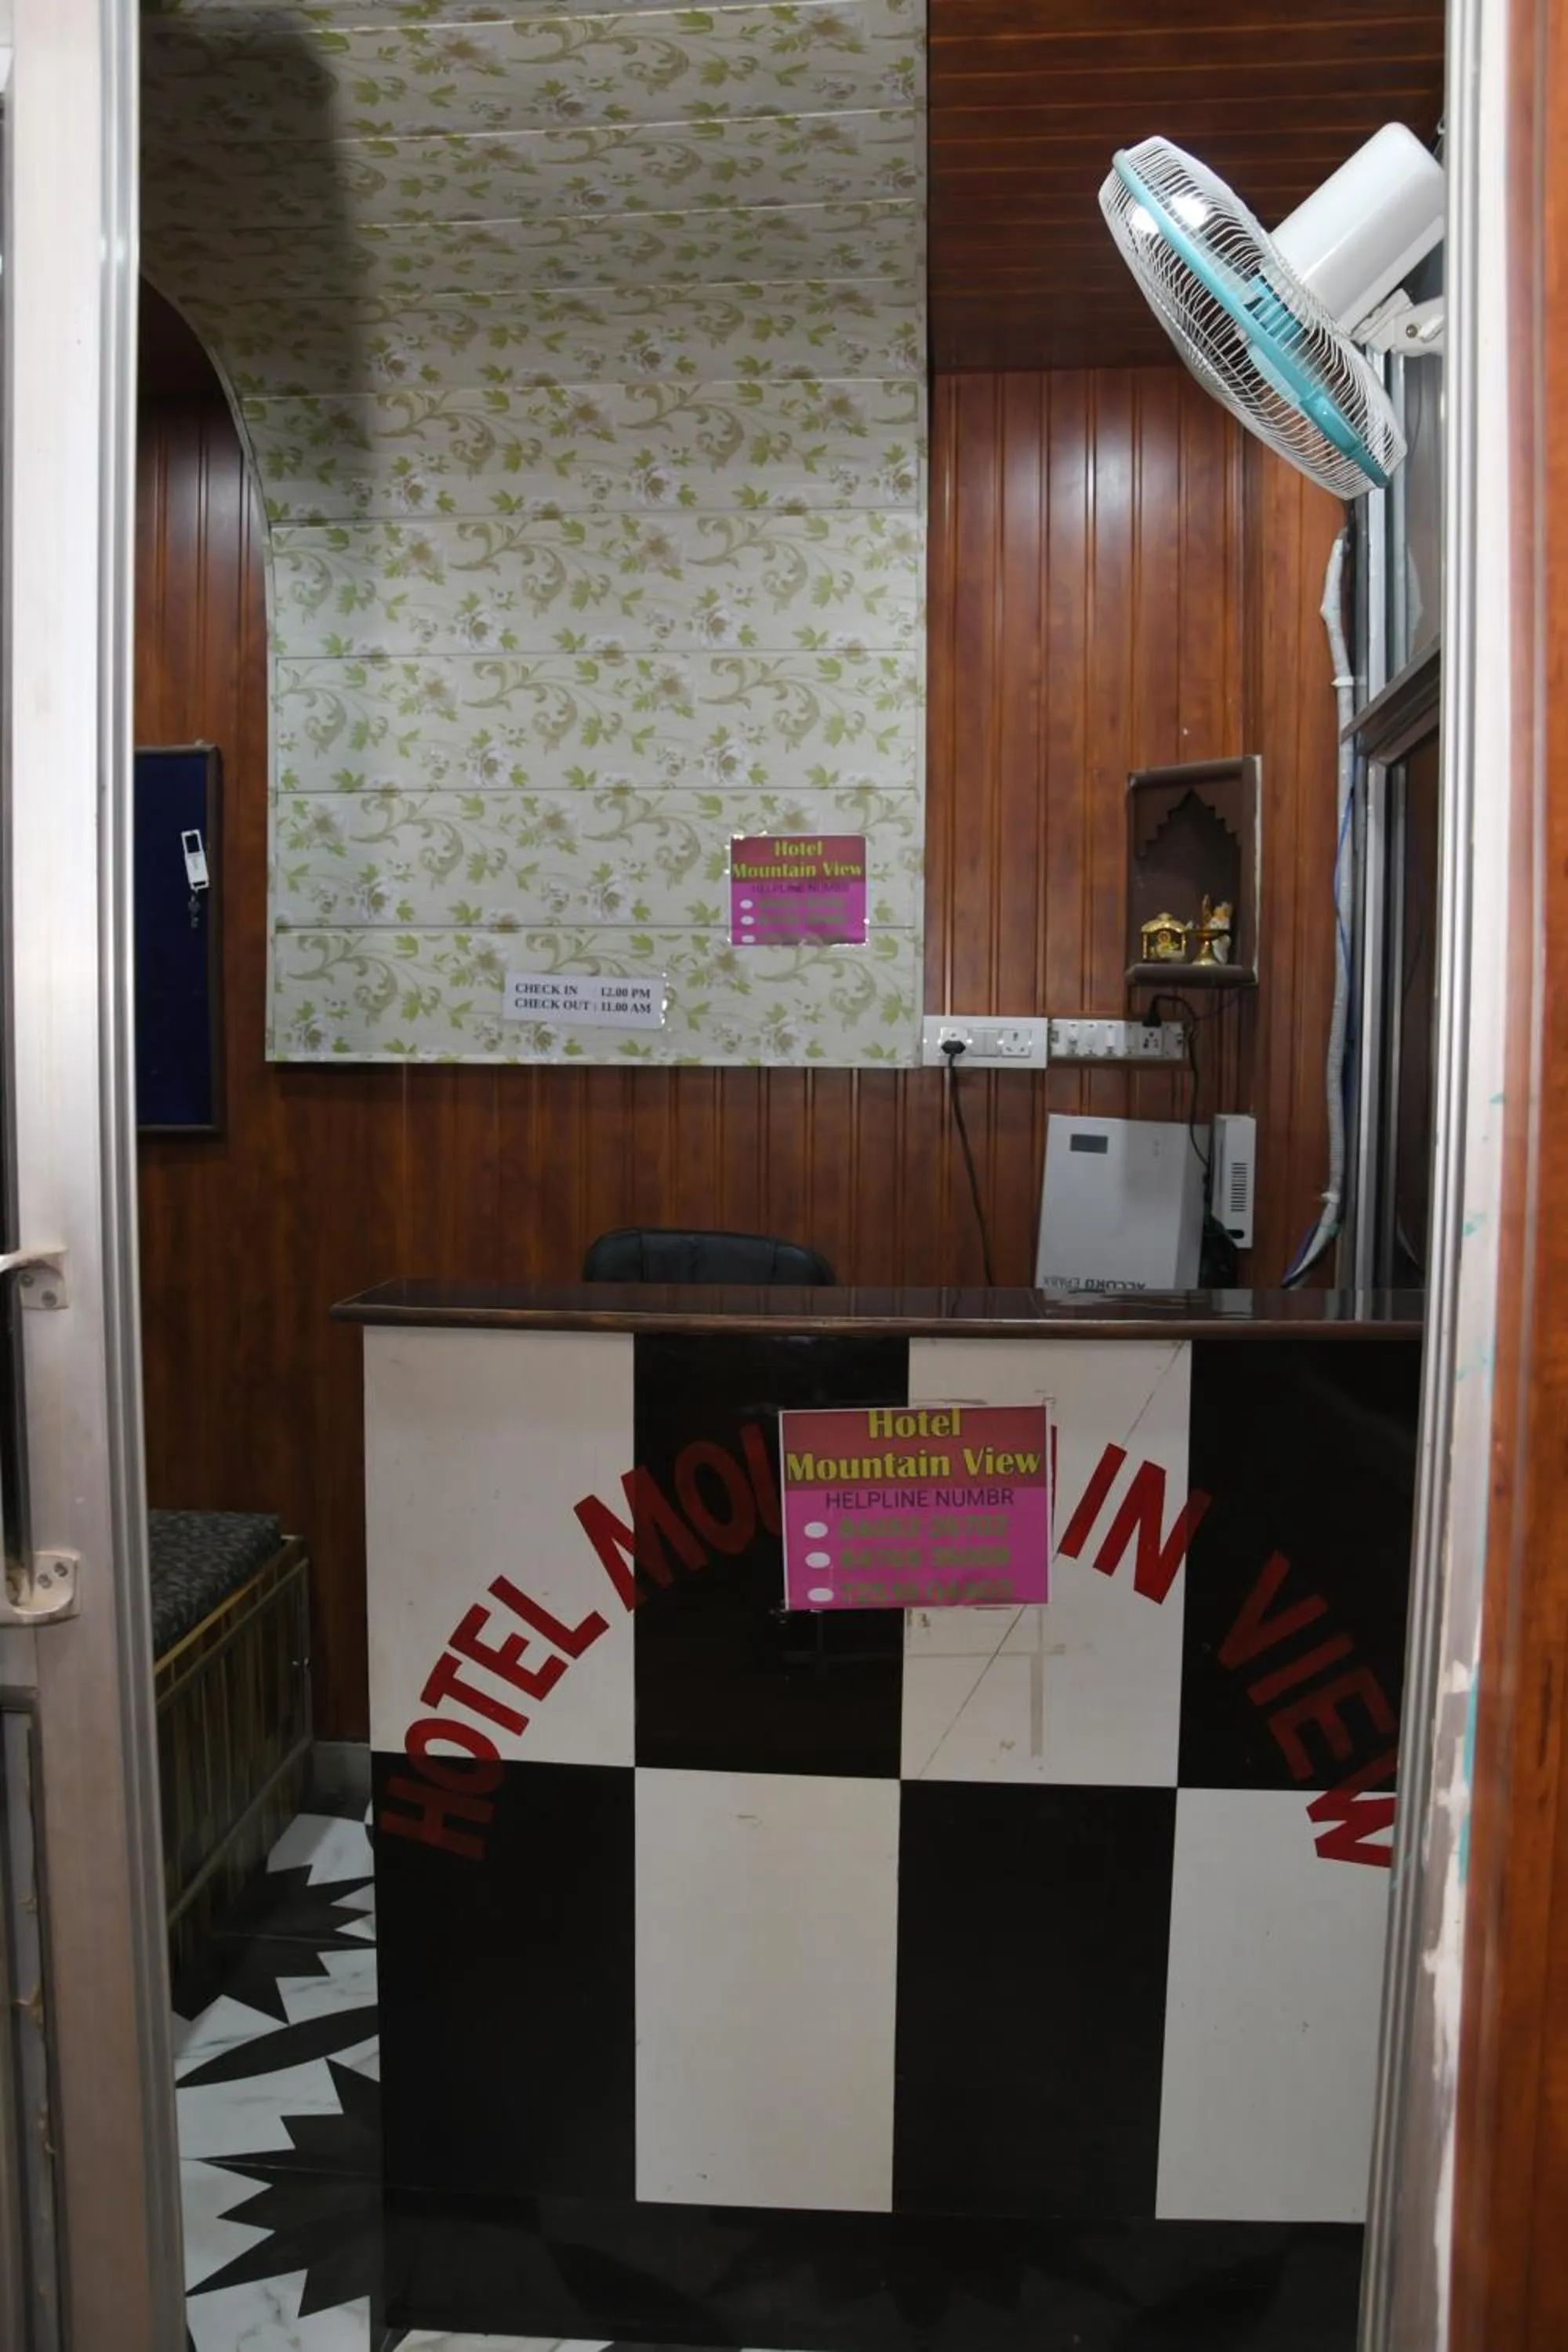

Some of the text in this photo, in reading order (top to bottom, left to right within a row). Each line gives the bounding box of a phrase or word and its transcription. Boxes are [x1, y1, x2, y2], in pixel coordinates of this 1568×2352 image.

[774, 840, 823, 856] Hotel
[733, 861, 862, 878] Mountain View
[515, 982, 651, 999] CHECK IN 12.00 PM
[514, 997, 651, 1014] CHECK OUT 11.00 AM
[868, 1408, 962, 1439] Hotel
[786, 1446, 1040, 1481] Mountain View
[826, 1488, 1014, 1510] HELPLINE NUMBR
[379, 1575, 610, 1861] HOTEL
[573, 1422, 1214, 1613] MOIN
